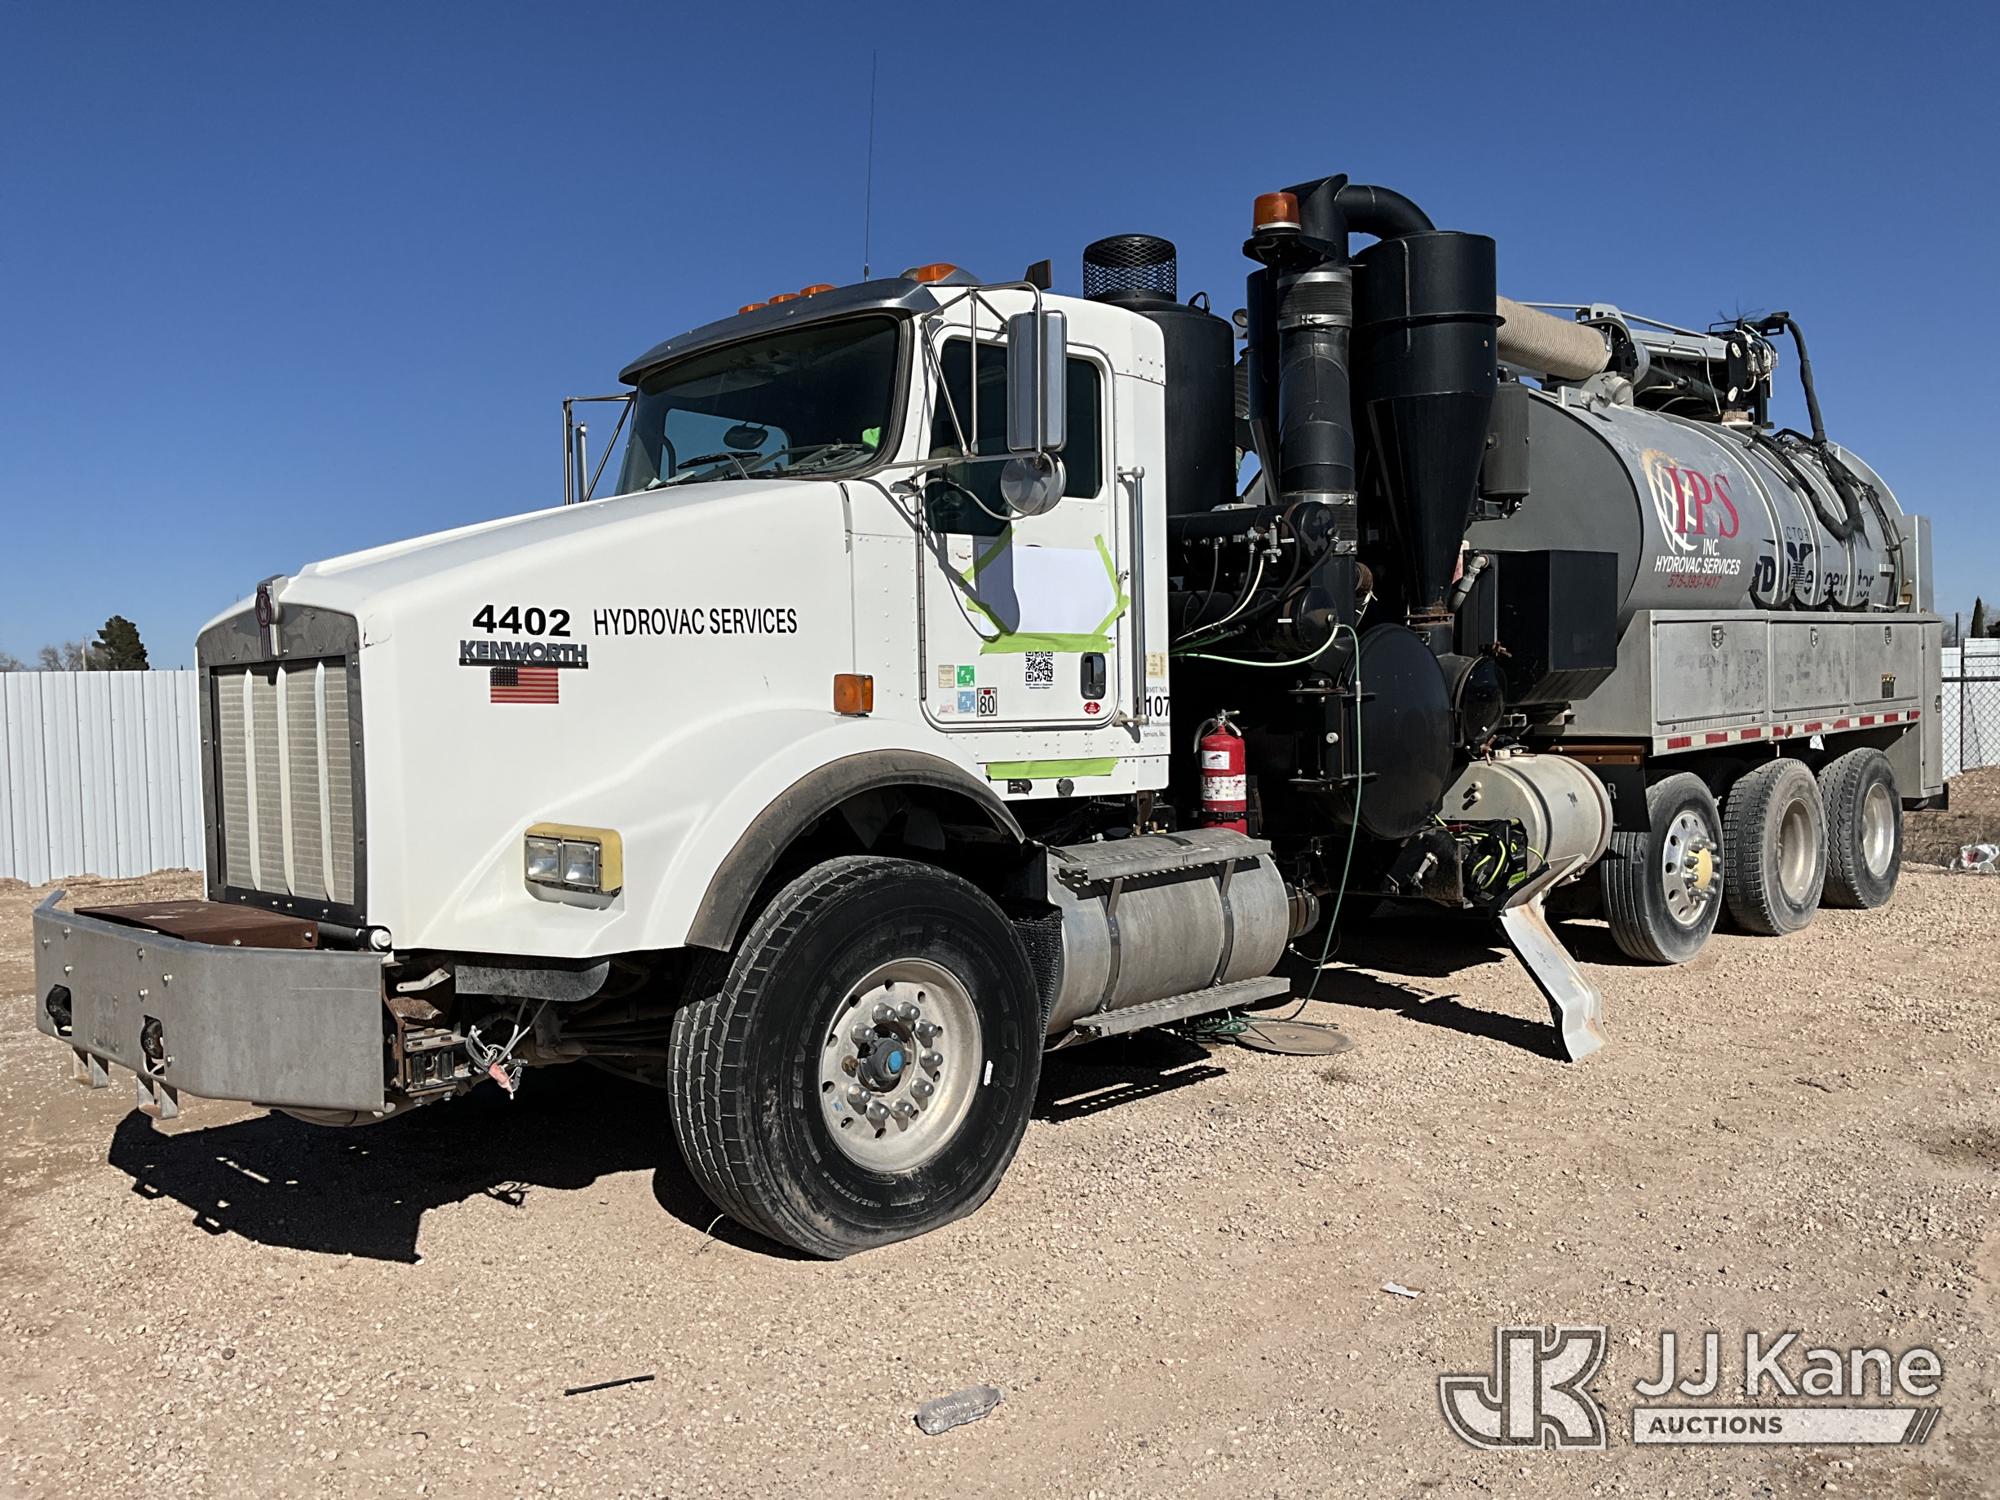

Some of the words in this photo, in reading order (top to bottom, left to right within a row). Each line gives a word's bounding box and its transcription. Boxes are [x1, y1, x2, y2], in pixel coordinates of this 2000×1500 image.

[1661, 466, 1739, 538] IPS
[1702, 538, 1720, 556] INC.
[1654, 556, 1702, 573] HYDROVAC
[1702, 558, 1741, 575] SERVICES
[472, 604, 571, 637] 4402
[594, 608, 705, 636] HYDROVAC
[709, 608, 798, 635] SERVICES
[459, 640, 588, 663] KENWORTH
[979, 695, 995, 714] 80
[1136, 696, 1171, 717] 107
